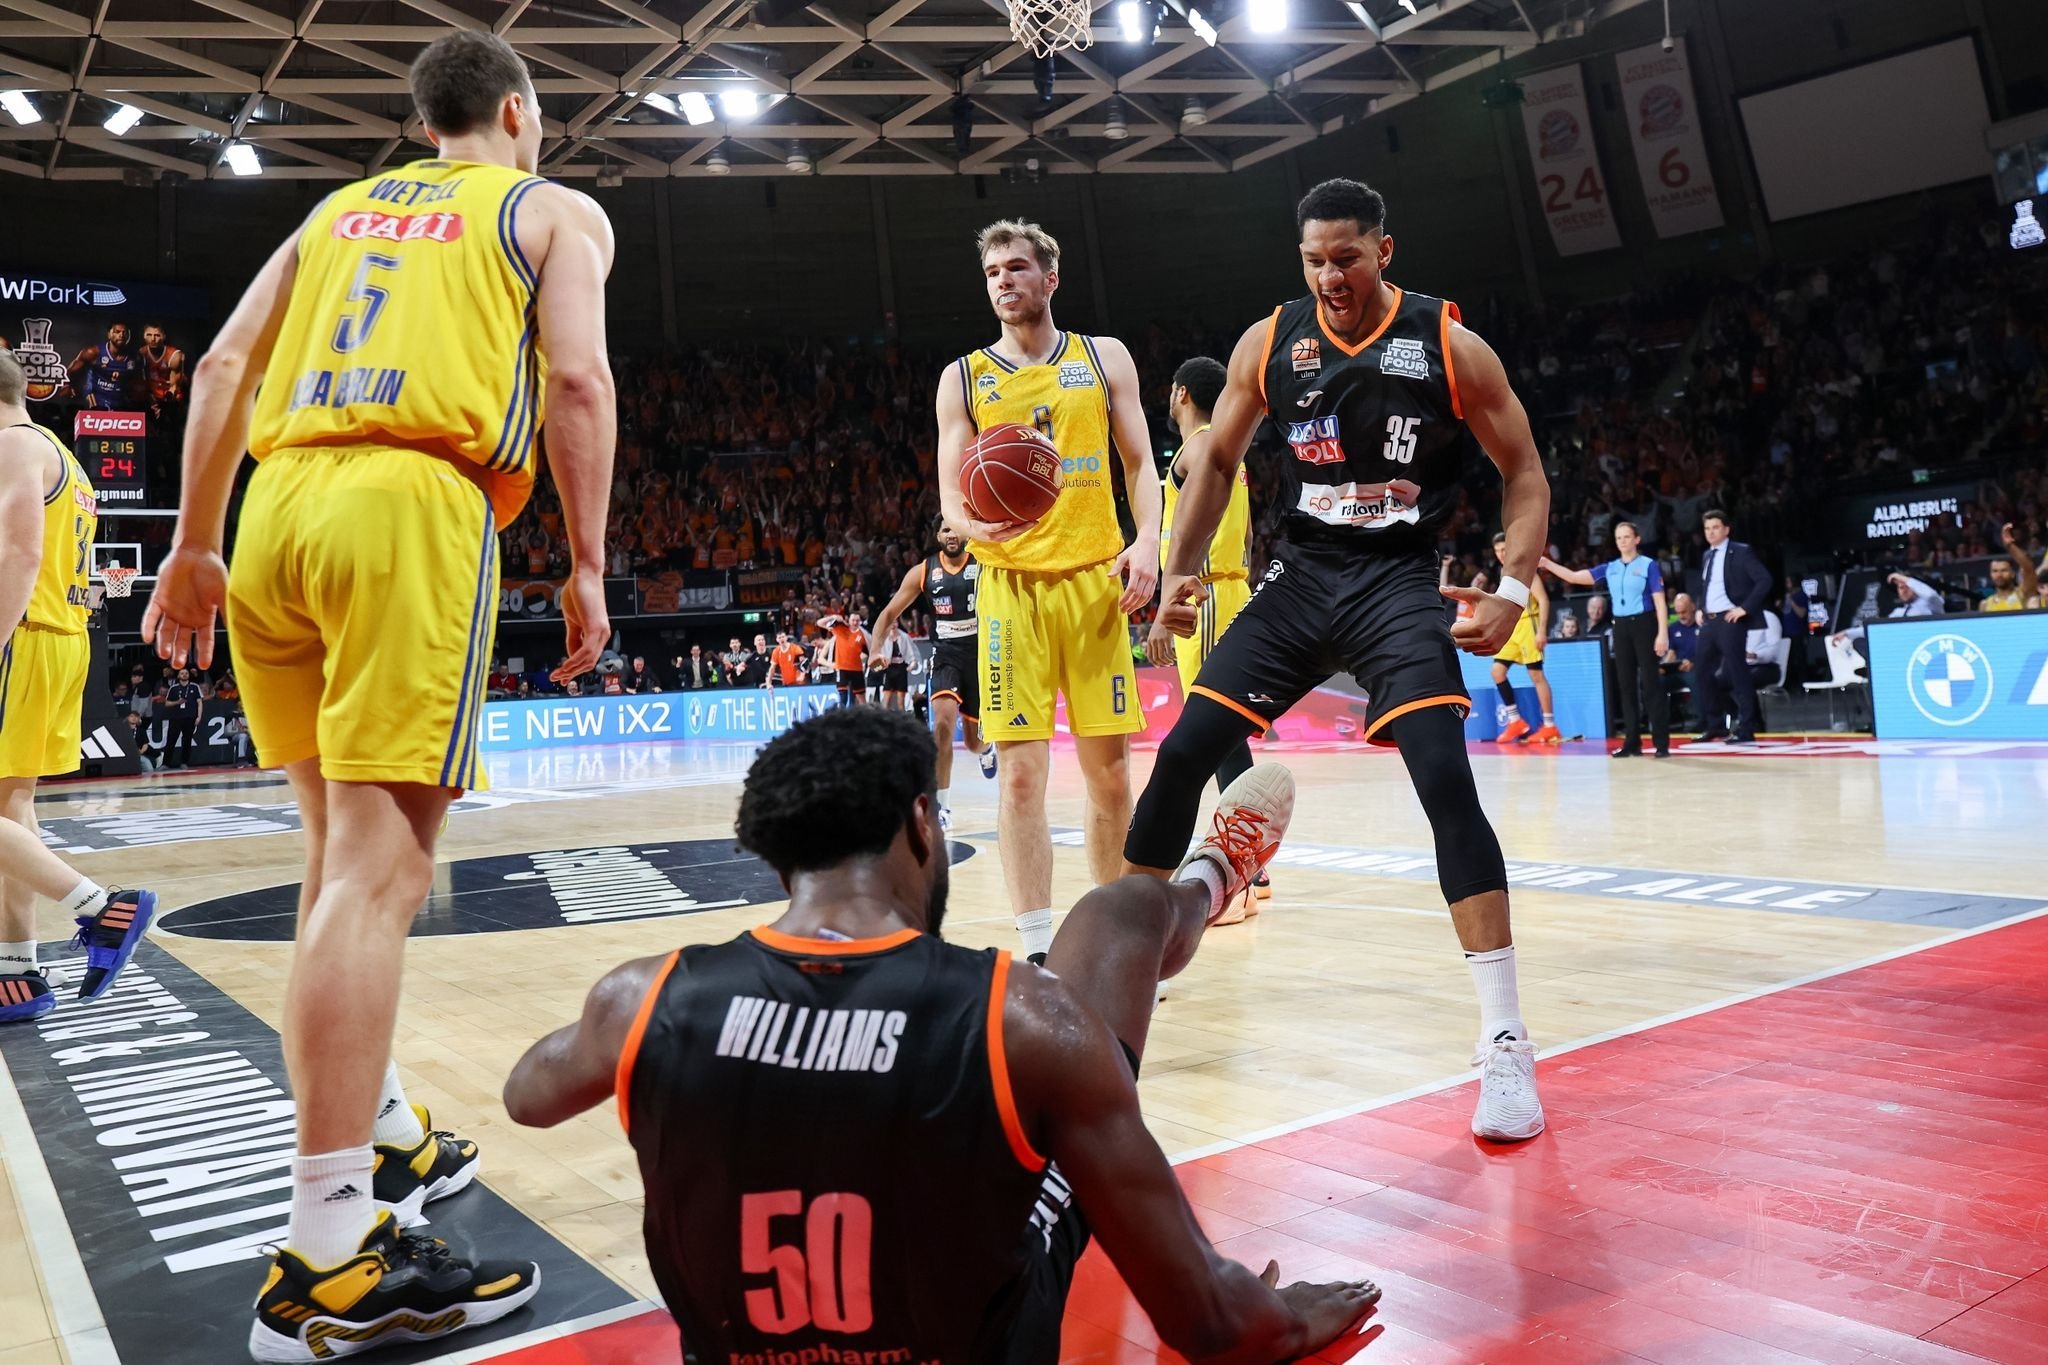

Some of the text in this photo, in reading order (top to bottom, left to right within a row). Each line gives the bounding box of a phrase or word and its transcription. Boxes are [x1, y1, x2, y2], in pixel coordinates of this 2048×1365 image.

[1658, 146, 1691, 188] 6
[1539, 166, 1604, 213] 24
[332, 252, 400, 354] 5
[17, 352, 57, 365] TOP
[1383, 356, 1426, 372] FOUR
[1390, 347, 1422, 360] TOP
[23, 365, 64, 378] OUR
[1060, 374, 1094, 386] FOUR
[1061, 367, 1088, 376] TOP
[332, 367, 406, 408] BRLIN
[82, 414, 143, 432] tipico
[1032, 405, 1054, 441] 6
[1383, 415, 1422, 464] 35
[101, 457, 134, 478] 24
[1031, 462, 1051, 478] BBL
[94, 488, 144, 503] egmund
[1060, 478, 1101, 489] olutions
[1308, 497, 1332, 515] 50
[1873, 503, 1909, 522] ALBA
[1866, 517, 1930, 539] RATIOPH
[1916, 638, 1980, 667] BMW
[987, 619, 1002, 712] interzero
[1111, 674, 1126, 715] 6
[478, 701, 673, 742] HE NEW iX2
[721, 698, 757, 731] THE
[761, 694, 802, 731] NEW
[1271, 846, 1434, 874] BANK
[1601, 878, 1873, 910] ALLE
[73, 889, 102, 911] adidas
[716, 995, 907, 1073] WILLIAMS
[51, 1031, 211, 1067] &
[740, 1189, 873, 1334] 50
